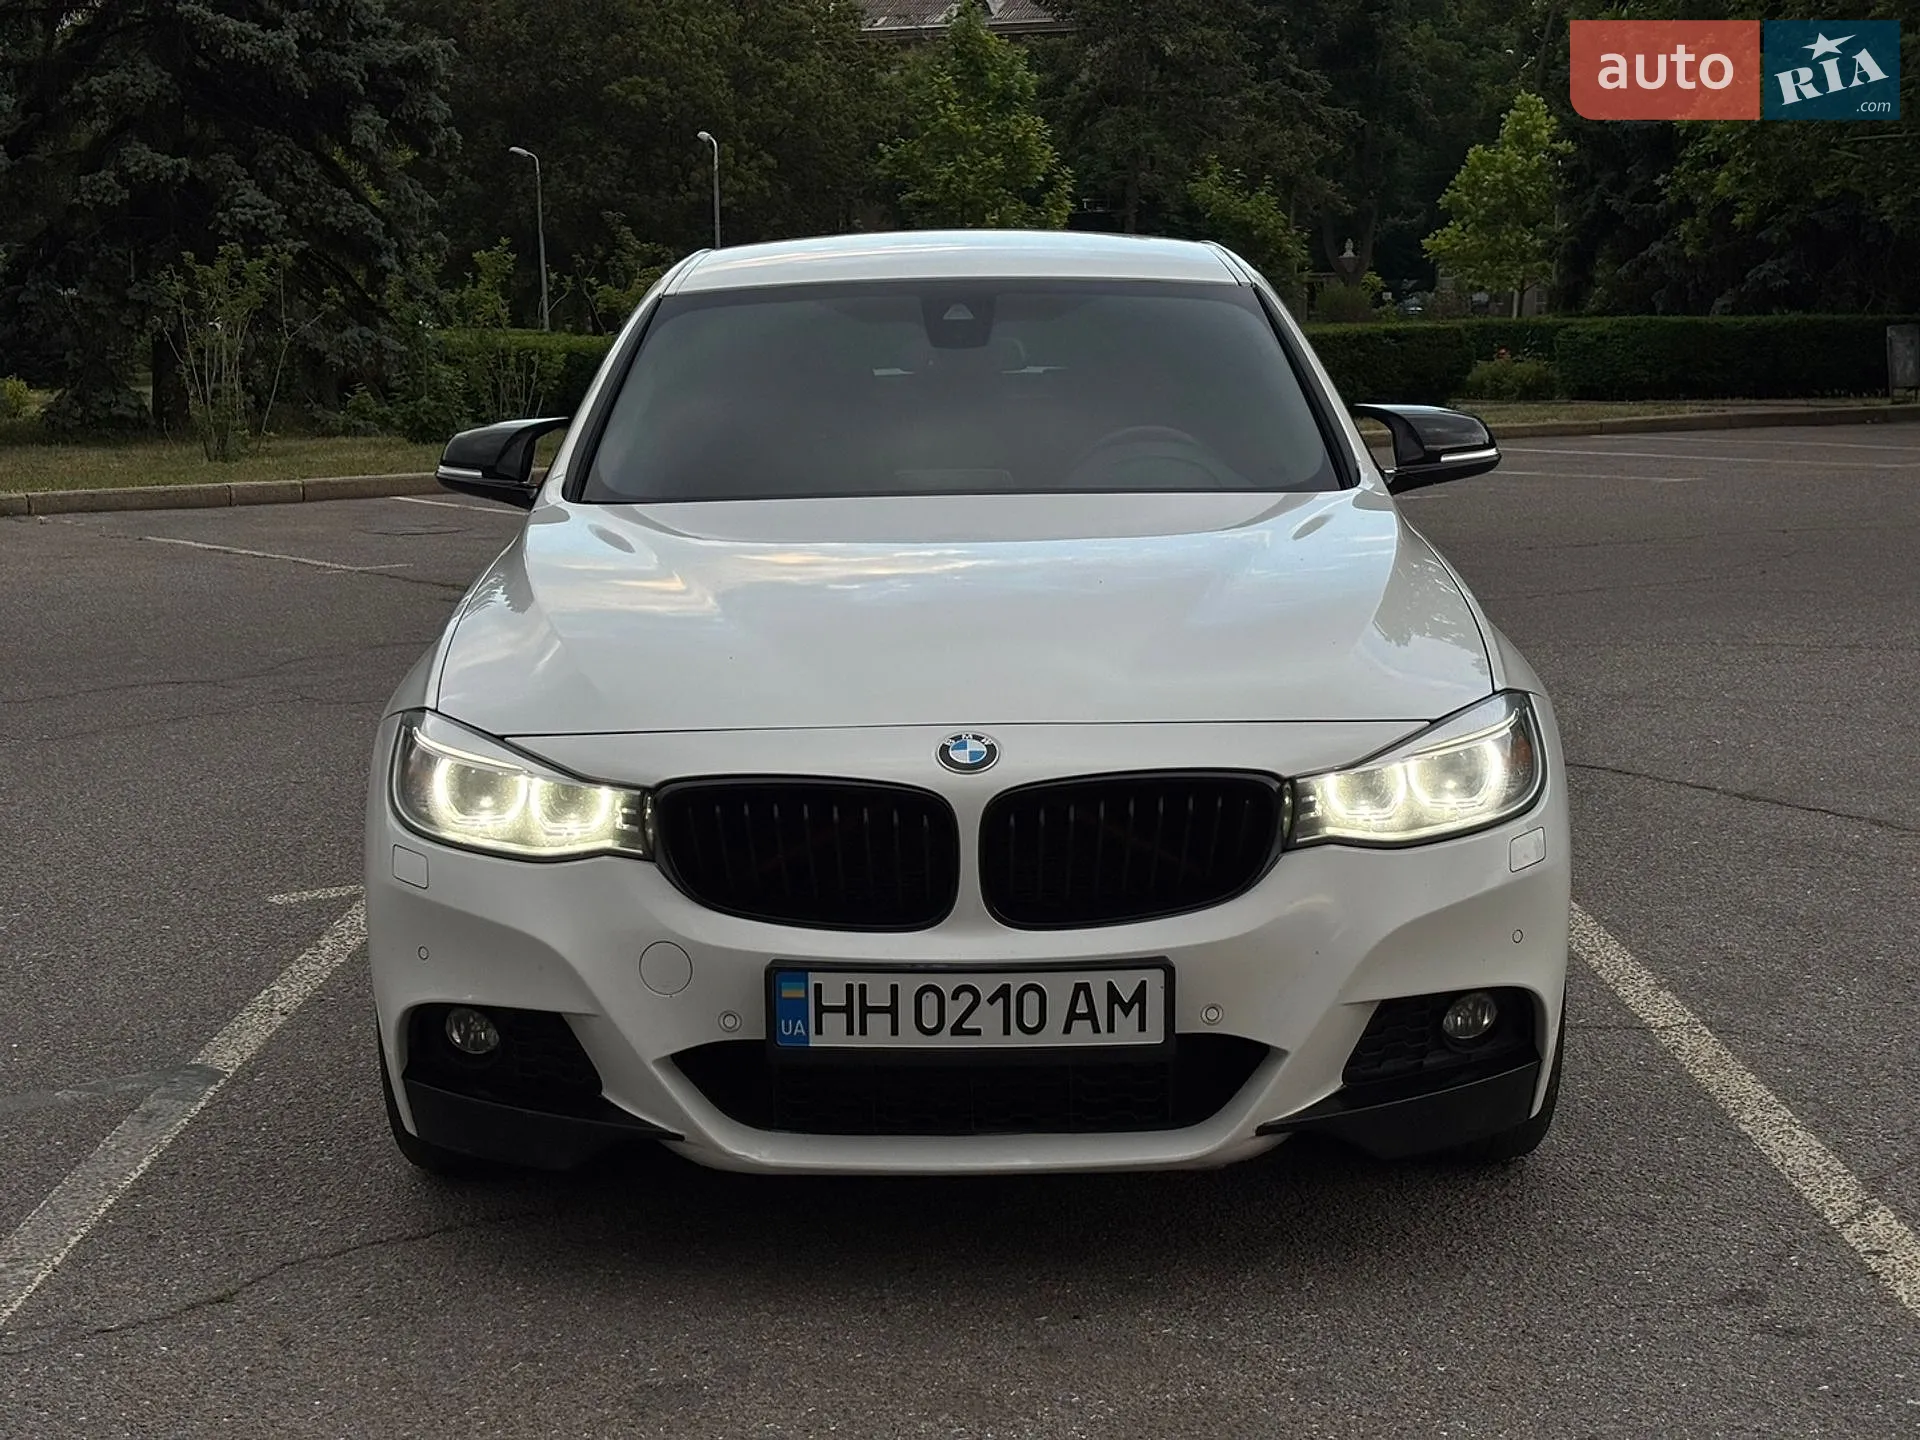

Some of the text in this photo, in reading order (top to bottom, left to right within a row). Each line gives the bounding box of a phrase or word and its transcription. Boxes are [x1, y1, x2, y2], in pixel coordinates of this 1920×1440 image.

[814, 979, 1148, 1036] HH 0210 AM
[781, 1019, 806, 1036] UA
